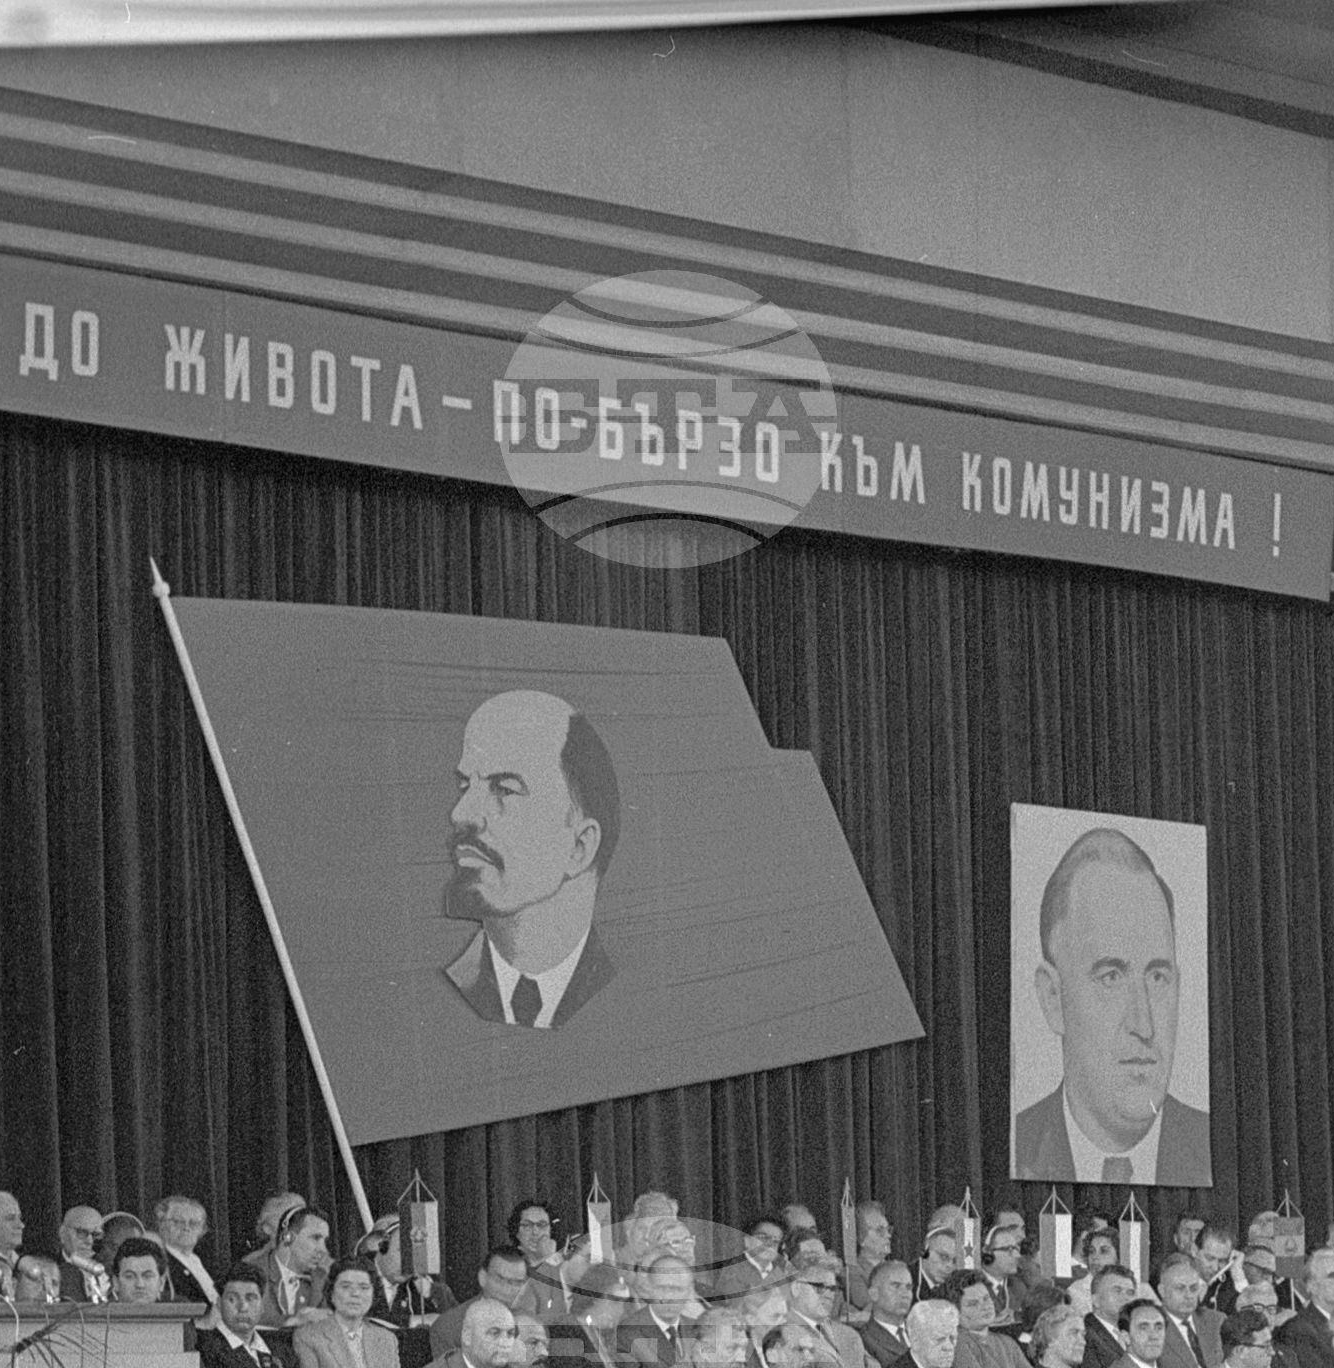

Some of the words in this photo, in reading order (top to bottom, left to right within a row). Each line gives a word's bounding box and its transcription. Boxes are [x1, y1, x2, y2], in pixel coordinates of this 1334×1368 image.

[18, 301, 100, 382] ДО
[820, 430, 926, 504] КЪМ
[961, 451, 1236, 550] КОМУНИЗМА
